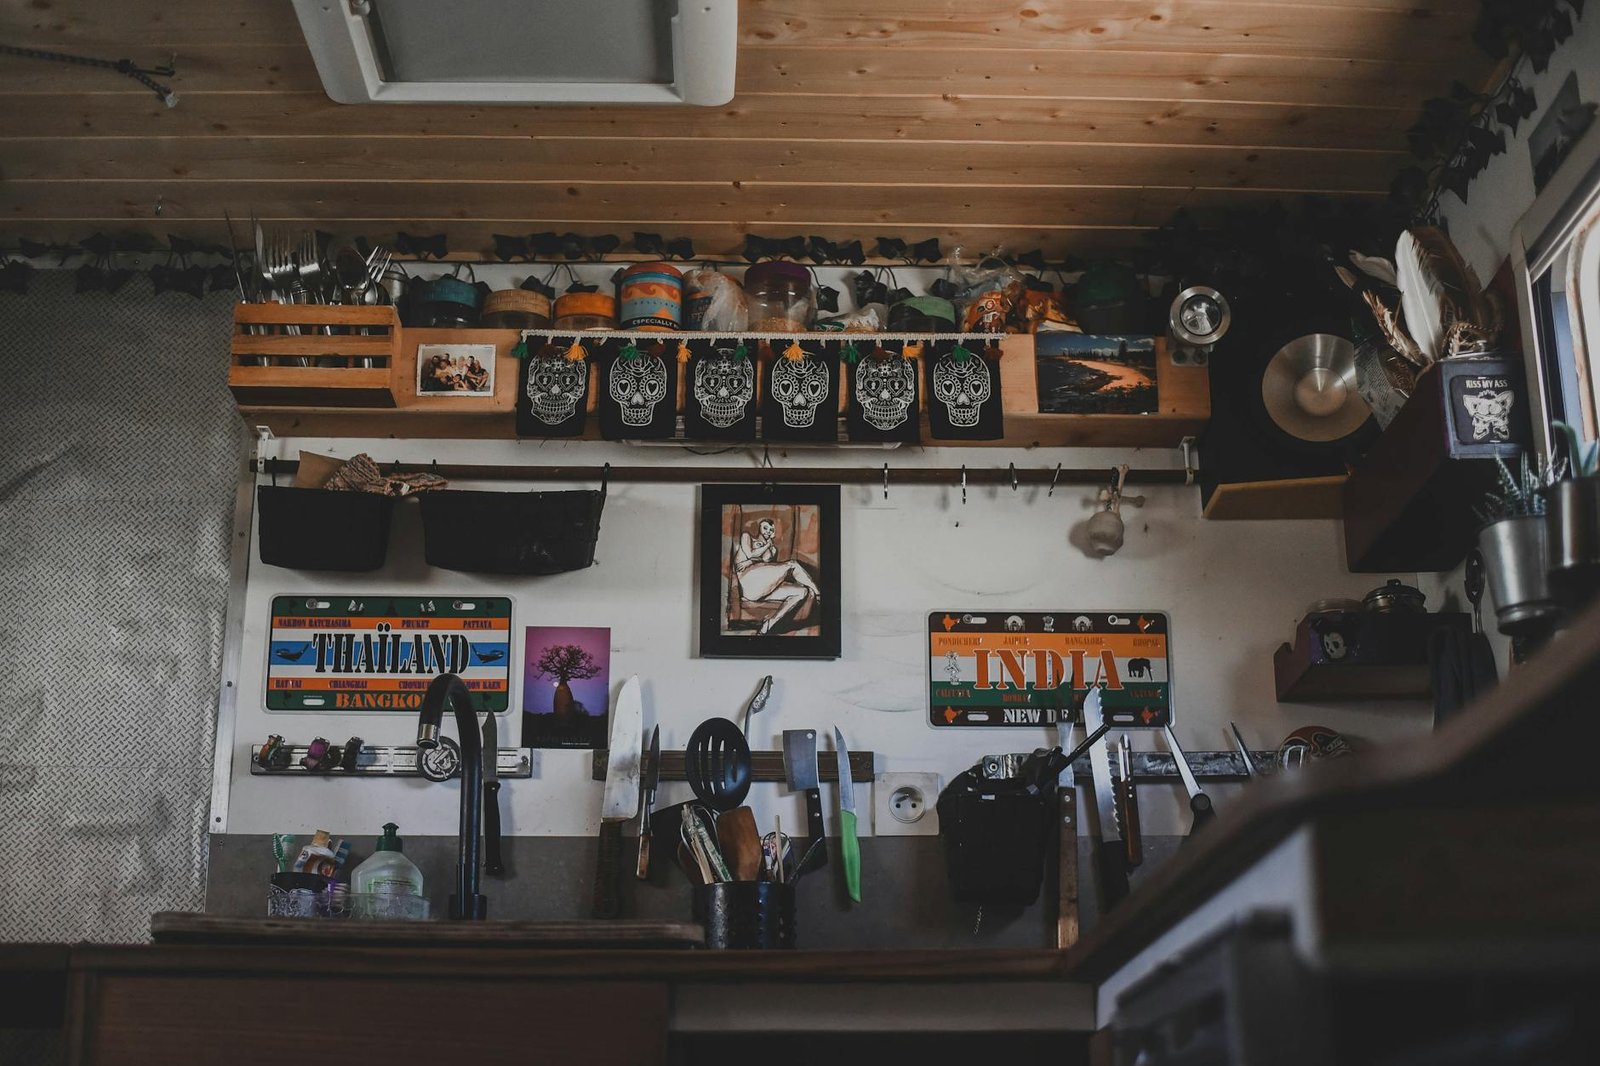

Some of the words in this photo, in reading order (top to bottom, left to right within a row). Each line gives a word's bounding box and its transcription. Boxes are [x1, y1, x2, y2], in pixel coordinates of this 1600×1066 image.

[1465, 379, 1481, 389] KISS
[1481, 379, 1493, 389] MY
[1494, 379, 1508, 388] ASS
[401, 619, 429, 628] PHUKET
[463, 620, 492, 629] PATTAYA
[973, 649, 1125, 691] INDIA
[336, 693, 426, 709] BANGKO
[1003, 708, 1041, 723] NEW
